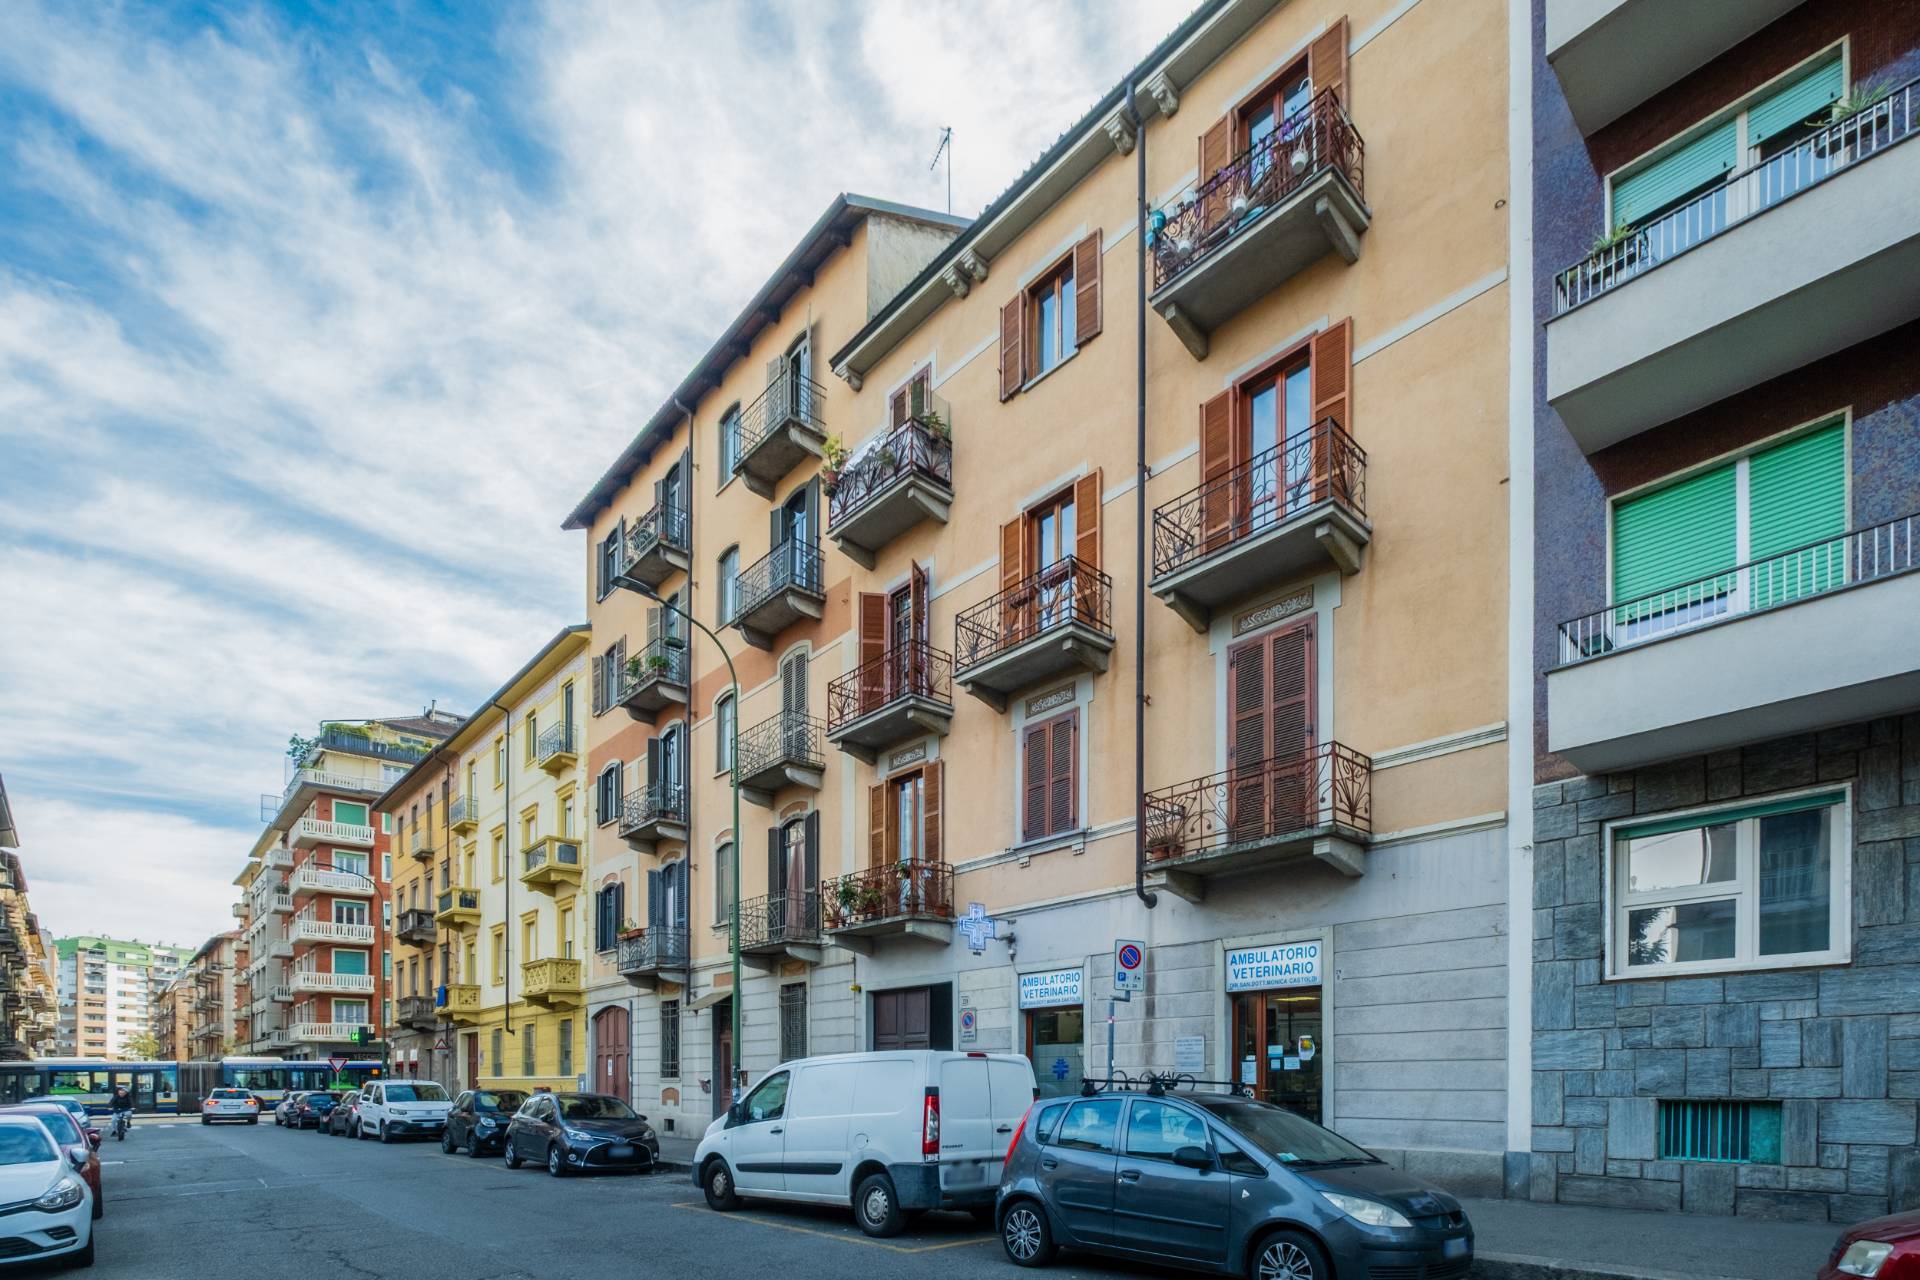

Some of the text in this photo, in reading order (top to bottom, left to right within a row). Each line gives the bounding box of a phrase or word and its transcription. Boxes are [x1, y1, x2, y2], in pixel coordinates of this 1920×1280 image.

[1230, 946, 1317, 966] AMBULATORIO
[1233, 961, 1314, 980] VETERINARIO
[1022, 972, 1081, 988] AMBULATORIO
[1023, 984, 1078, 999] VETERINARIO
